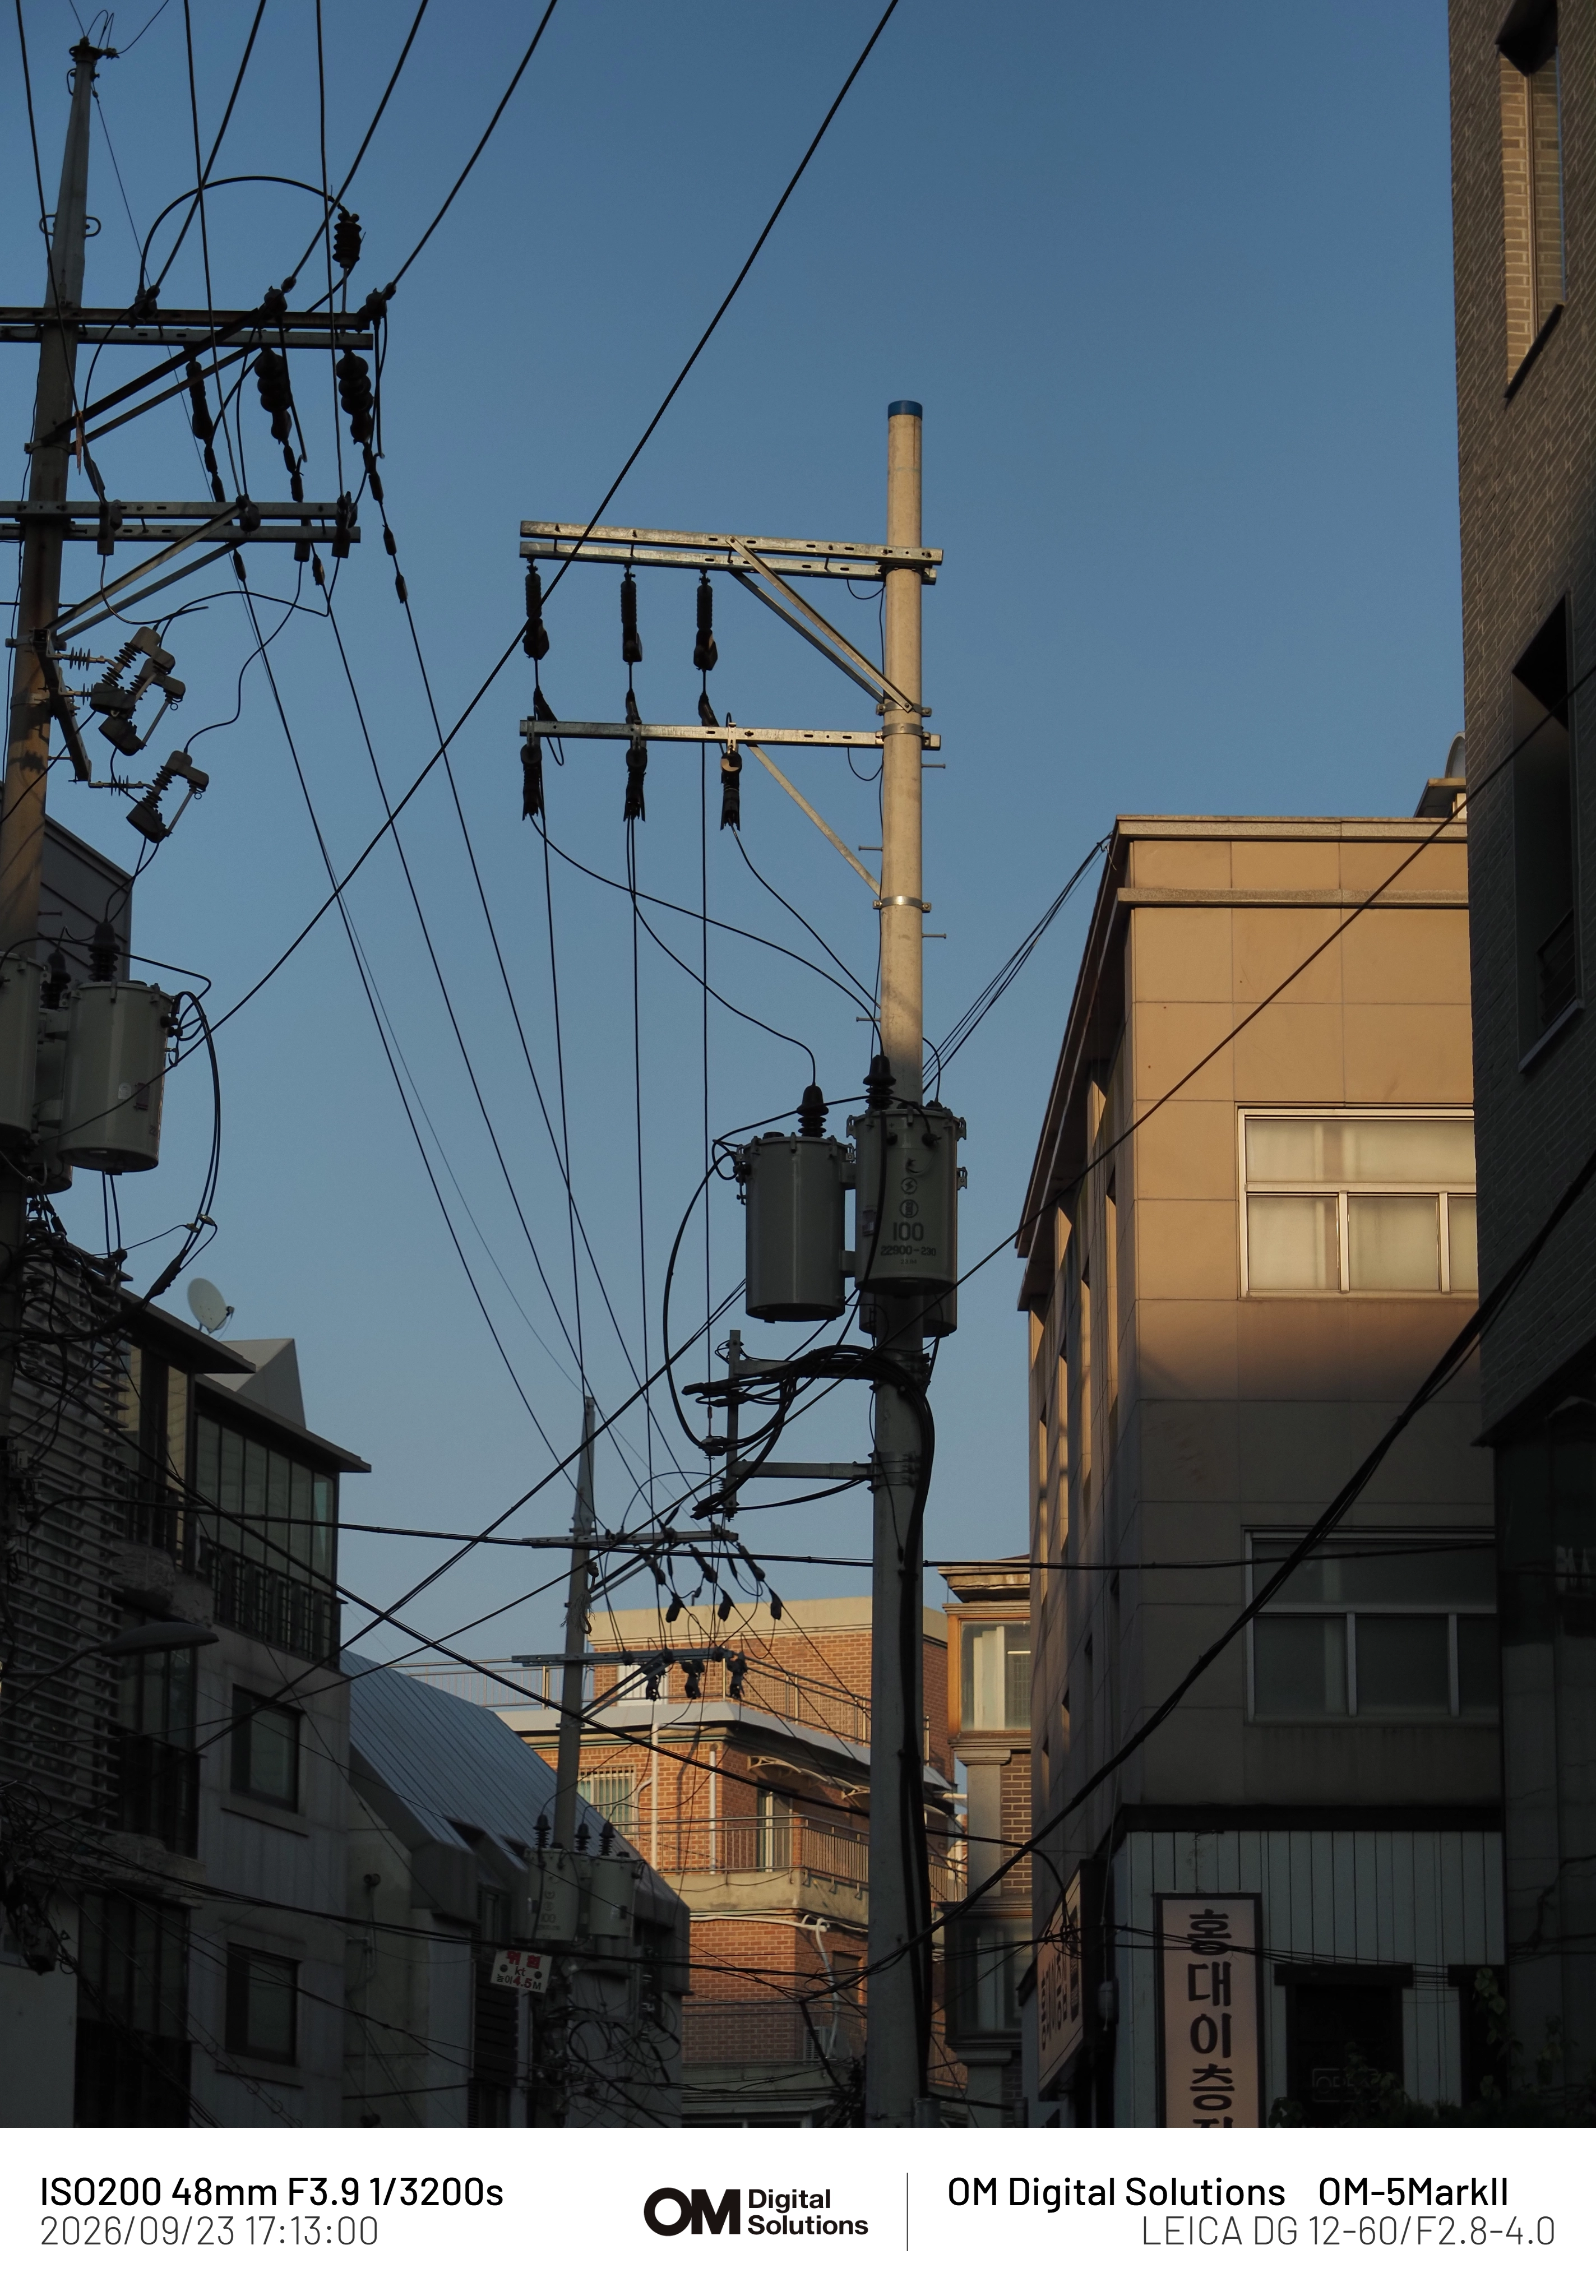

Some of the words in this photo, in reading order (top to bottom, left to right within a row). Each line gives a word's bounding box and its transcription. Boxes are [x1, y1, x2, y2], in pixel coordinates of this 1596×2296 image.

[893, 1222, 924, 1241] 100
[881, 1245, 936, 1256] 22900-230
[515, 1965, 526, 1976] kt
